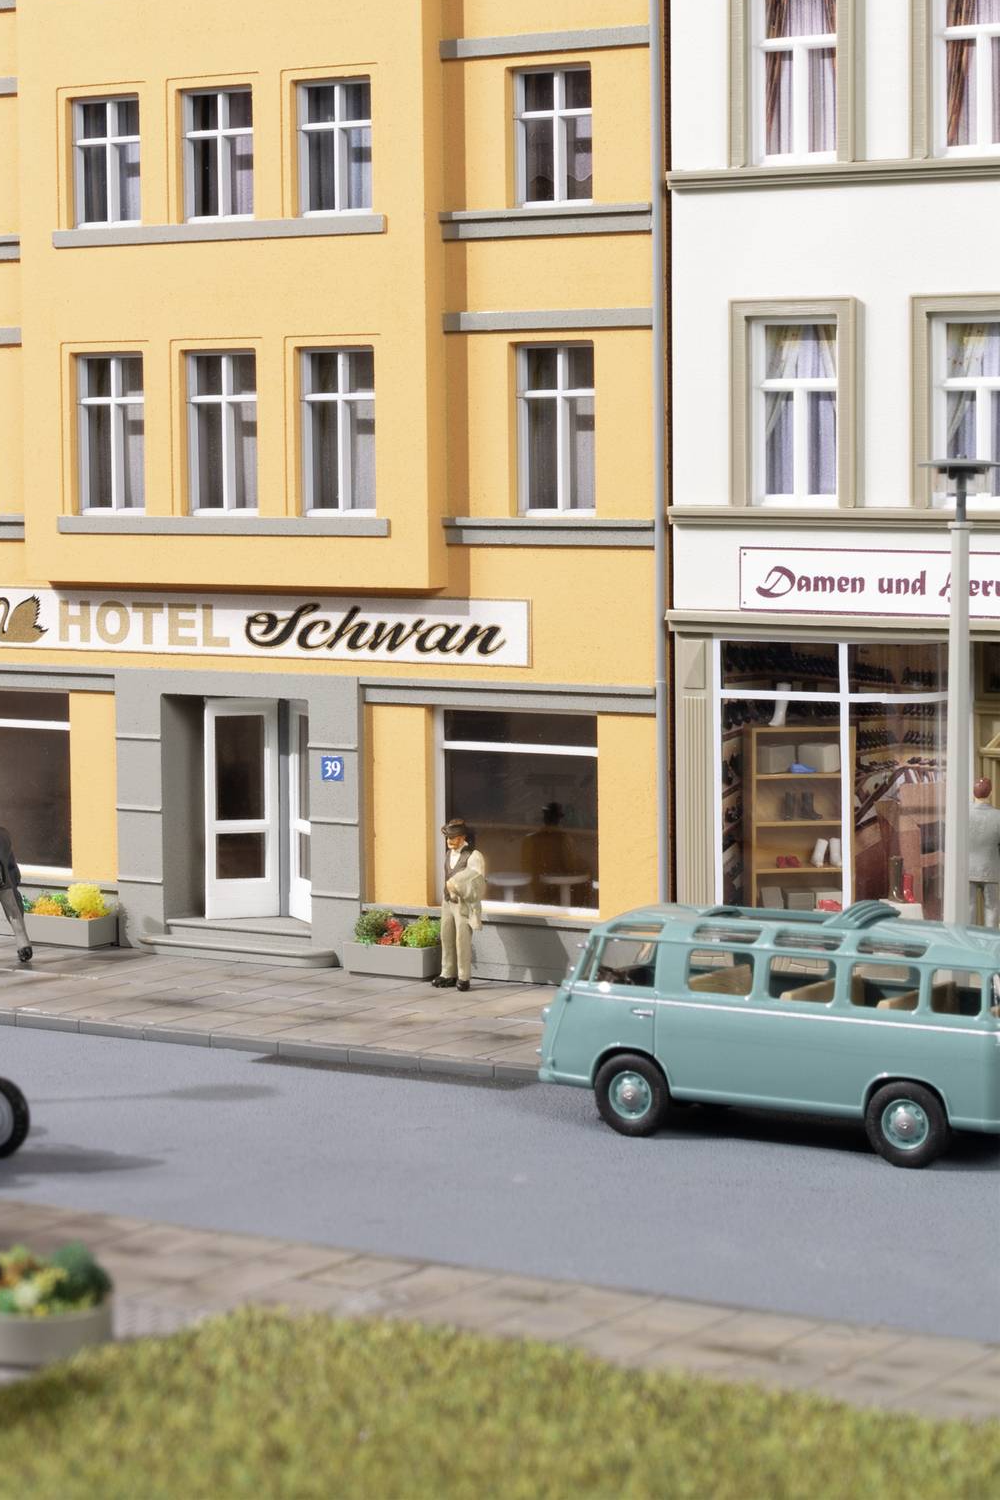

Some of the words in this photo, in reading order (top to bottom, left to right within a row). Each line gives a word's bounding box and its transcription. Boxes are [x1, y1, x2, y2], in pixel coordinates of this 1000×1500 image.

[756, 565, 865, 599] Damen
[877, 570, 926, 596] und
[59, 600, 230, 647] HOTEL
[245, 602, 507, 656] Schwan
[324, 761, 341, 778] 39
